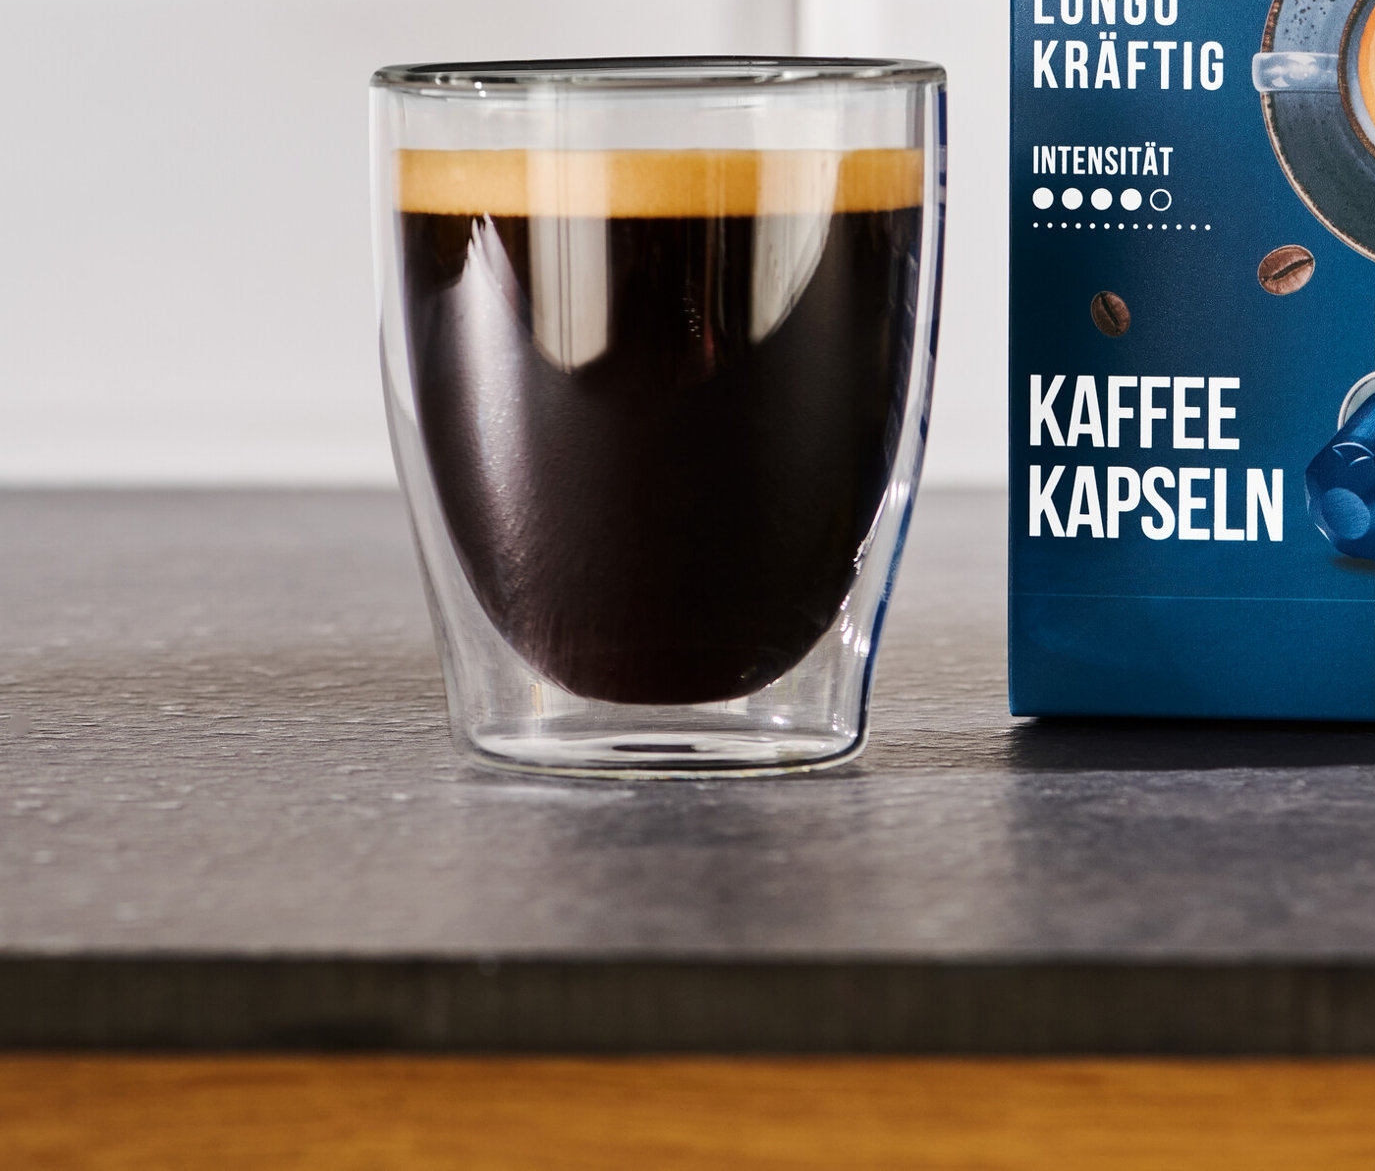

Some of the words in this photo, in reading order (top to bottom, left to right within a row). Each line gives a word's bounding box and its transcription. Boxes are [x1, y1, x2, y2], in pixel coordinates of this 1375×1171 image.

[1033, 31, 1224, 91] KRÄFTIG
[1033, 141, 1174, 176] INTENSITÄT
[1029, 374, 1241, 450] KAFFEE
[1029, 464, 1284, 542] KAPSELN
